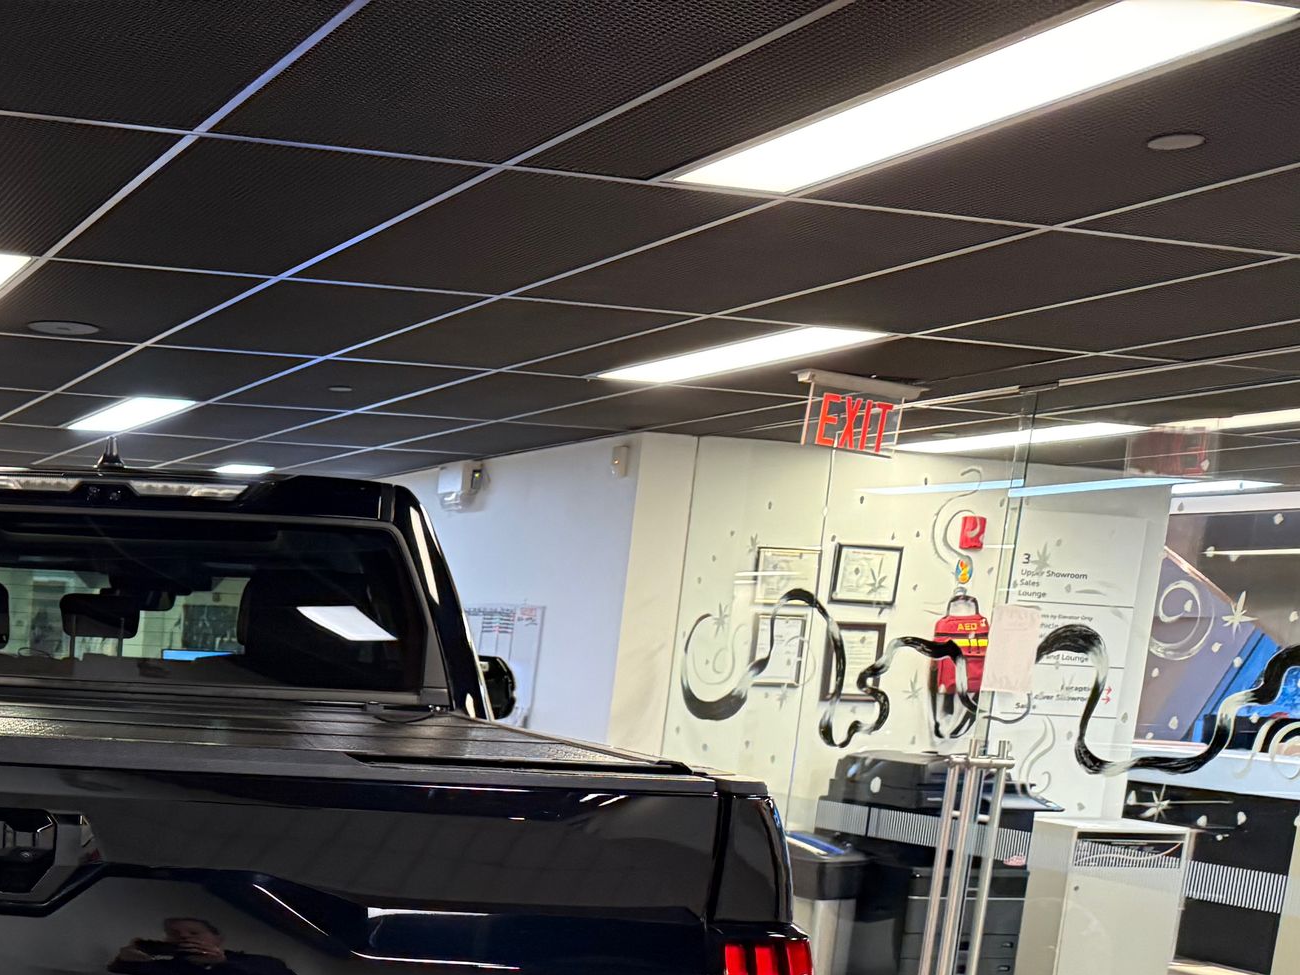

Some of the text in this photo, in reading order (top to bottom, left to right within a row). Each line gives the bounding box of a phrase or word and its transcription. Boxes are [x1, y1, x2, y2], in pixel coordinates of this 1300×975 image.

[815, 393, 893, 453] EXIT
[1022, 553, 1031, 564] 3
[1046, 570, 1088, 580] Showroom
[1020, 579, 1040, 587] Sales
[1018, 590, 1047, 599] Lounge
[957, 623, 977, 631] AED
